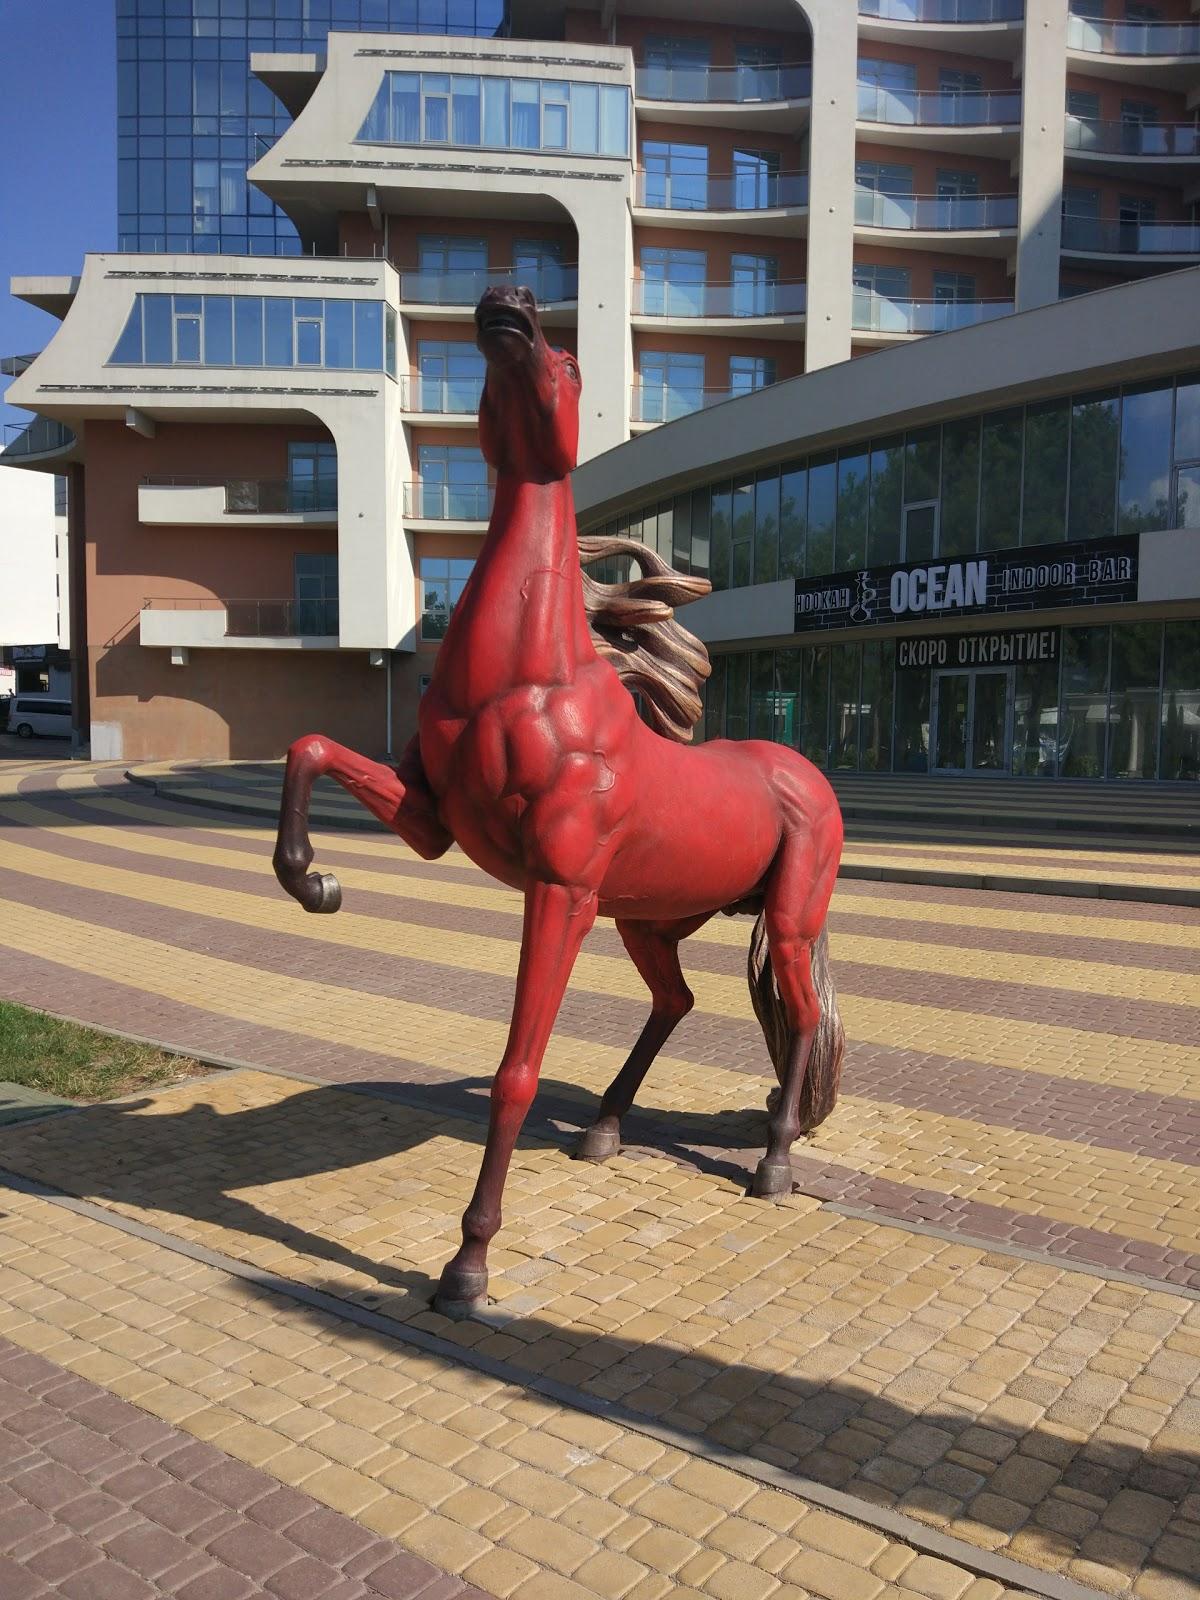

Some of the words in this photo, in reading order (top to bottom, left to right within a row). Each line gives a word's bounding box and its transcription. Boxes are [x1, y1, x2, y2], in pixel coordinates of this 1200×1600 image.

[796, 588, 850, 613] HOOKAH
[890, 560, 988, 613] OCEAN
[1002, 562, 1076, 591] INDOOR
[1088, 556, 1131, 582] BAR
[899, 639, 948, 666] СКОРО
[958, 631, 1056, 664] ОТКРЫТИЕ!
